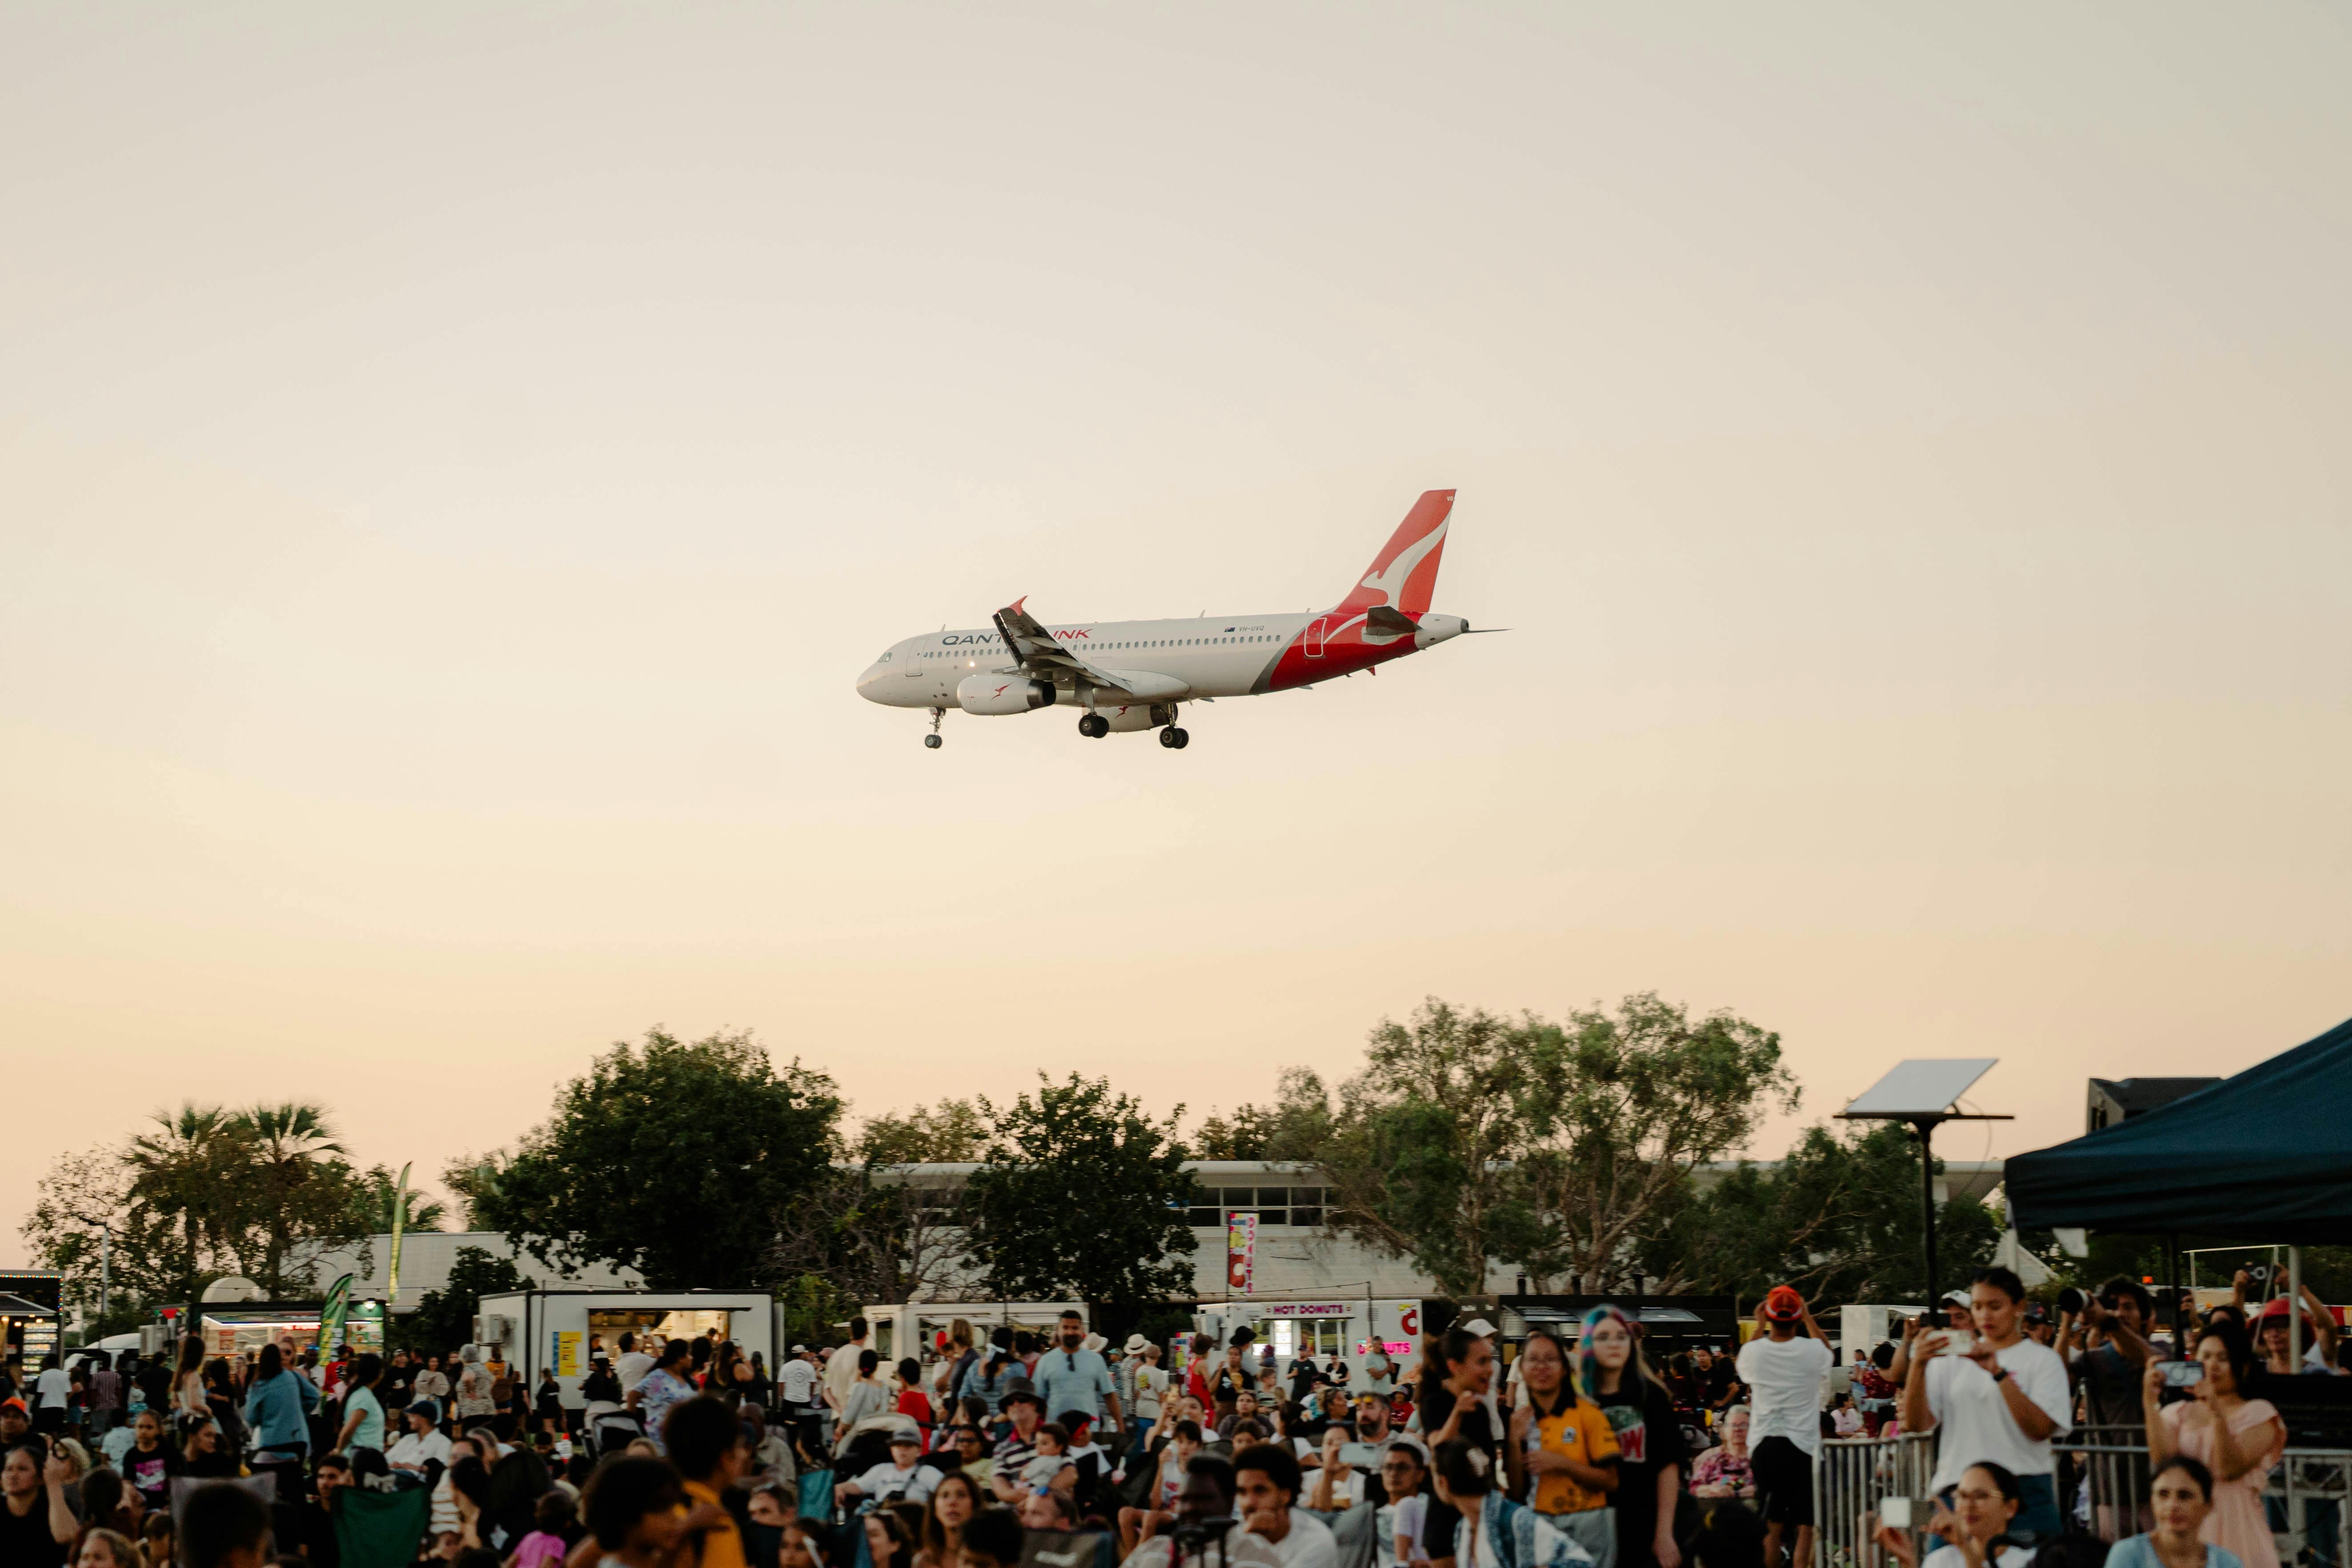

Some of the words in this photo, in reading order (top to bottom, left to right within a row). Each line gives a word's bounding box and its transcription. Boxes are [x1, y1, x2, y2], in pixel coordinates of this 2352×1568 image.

[942, 634, 1001, 645] QANT
[1274, 1305, 1295, 1314] HOT
[1300, 1304, 1342, 1314] DONUTS
